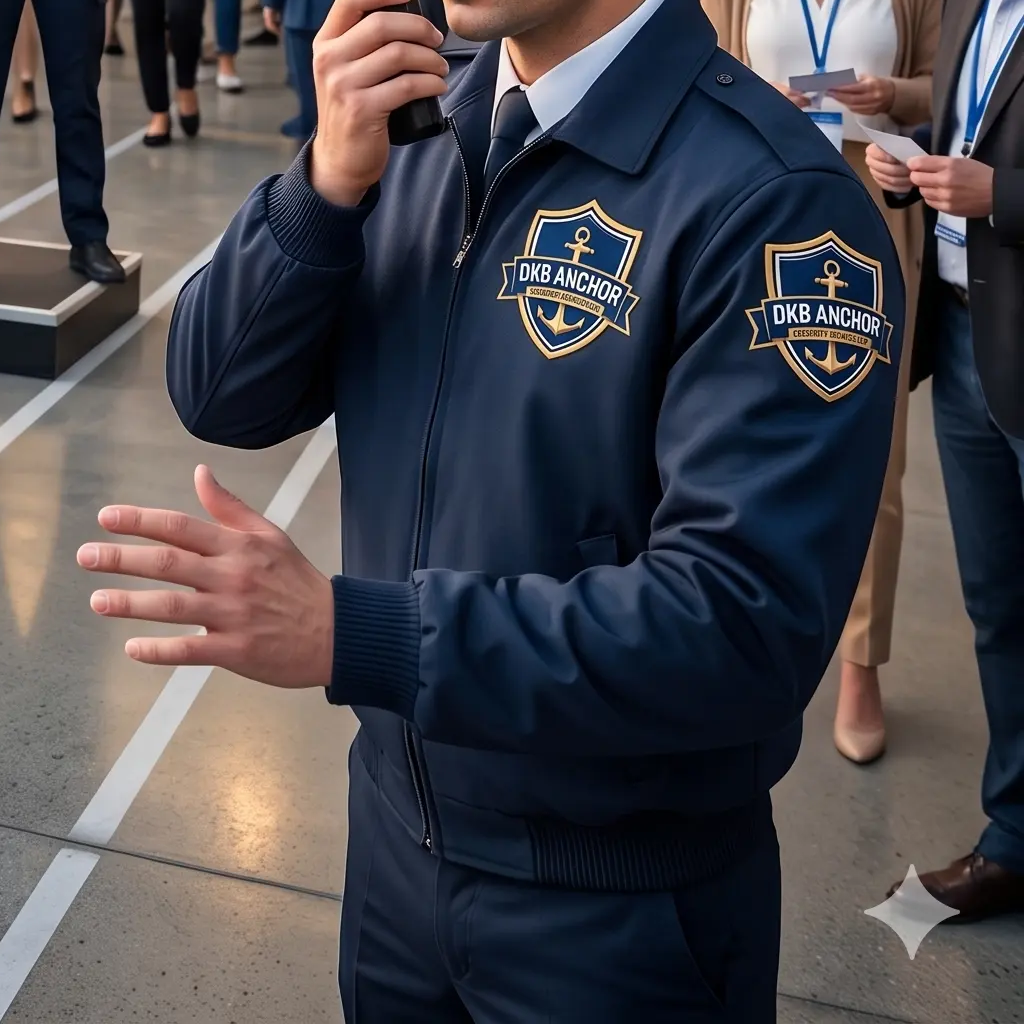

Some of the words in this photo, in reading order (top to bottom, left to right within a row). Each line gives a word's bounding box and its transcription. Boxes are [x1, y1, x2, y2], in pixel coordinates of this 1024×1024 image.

[519, 262, 552, 283] DKB
[553, 265, 623, 307] ANCHOR
[772, 303, 811, 325] DKB
[815, 304, 881, 337] ANCHOR
